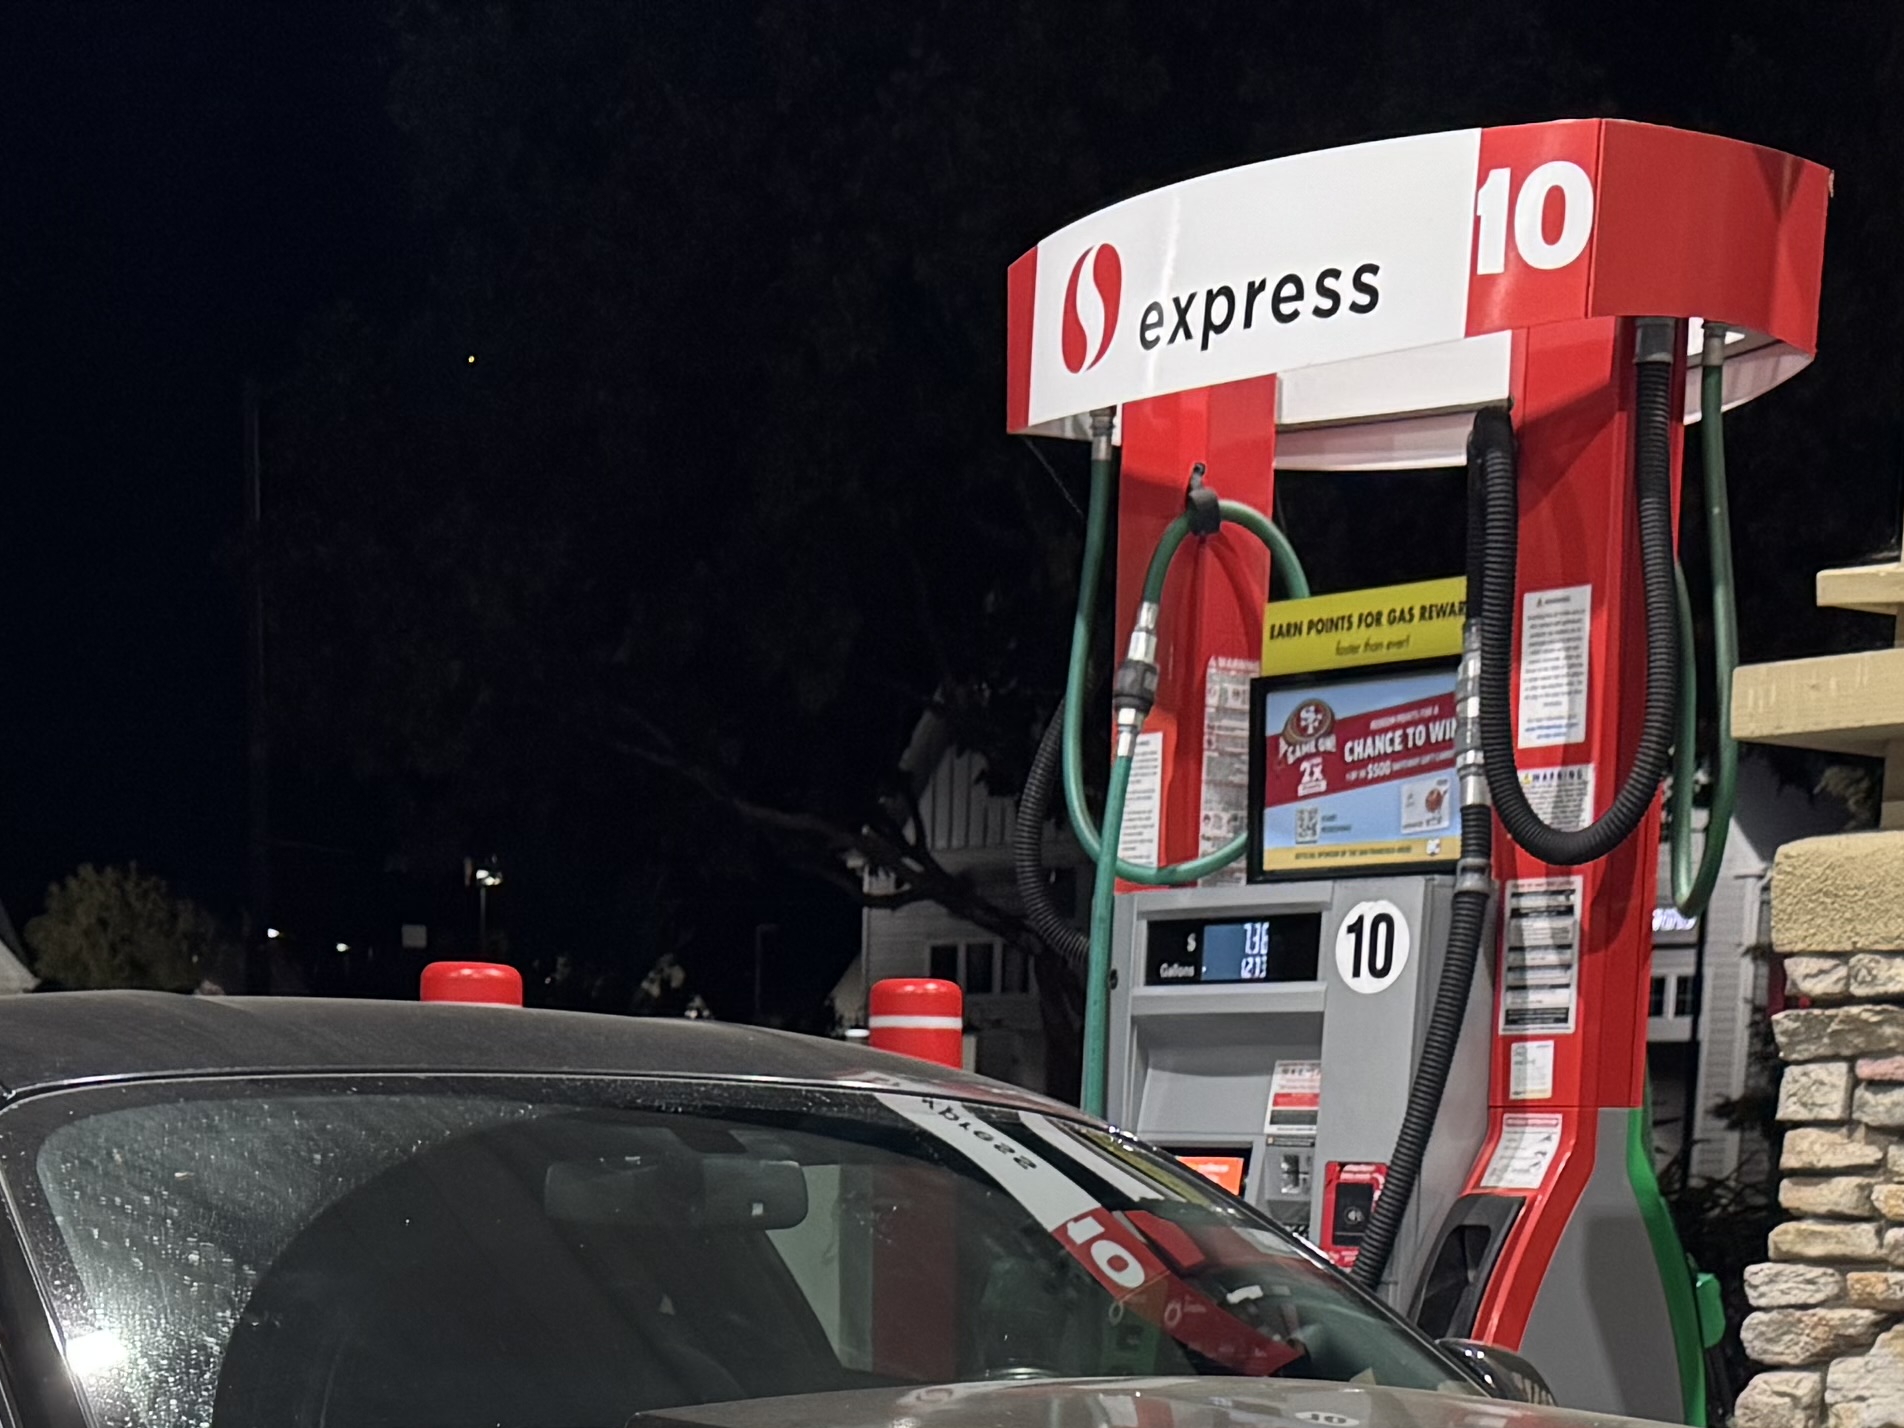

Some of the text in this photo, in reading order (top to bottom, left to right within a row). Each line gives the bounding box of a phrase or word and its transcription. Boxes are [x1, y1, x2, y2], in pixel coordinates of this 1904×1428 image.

[1476, 160, 1594, 275] 10
[1139, 263, 1380, 351] express
[1270, 621, 1303, 640] EARN
[1307, 613, 1353, 636] POINTS
[1357, 609, 1383, 629] FOR
[1387, 605, 1415, 625] GAS
[1344, 728, 1404, 763] CHANCE
[1406, 724, 1426, 749] TO
[1159, 963, 1195, 979] Gallons
[1346, 912, 1395, 979] 10
